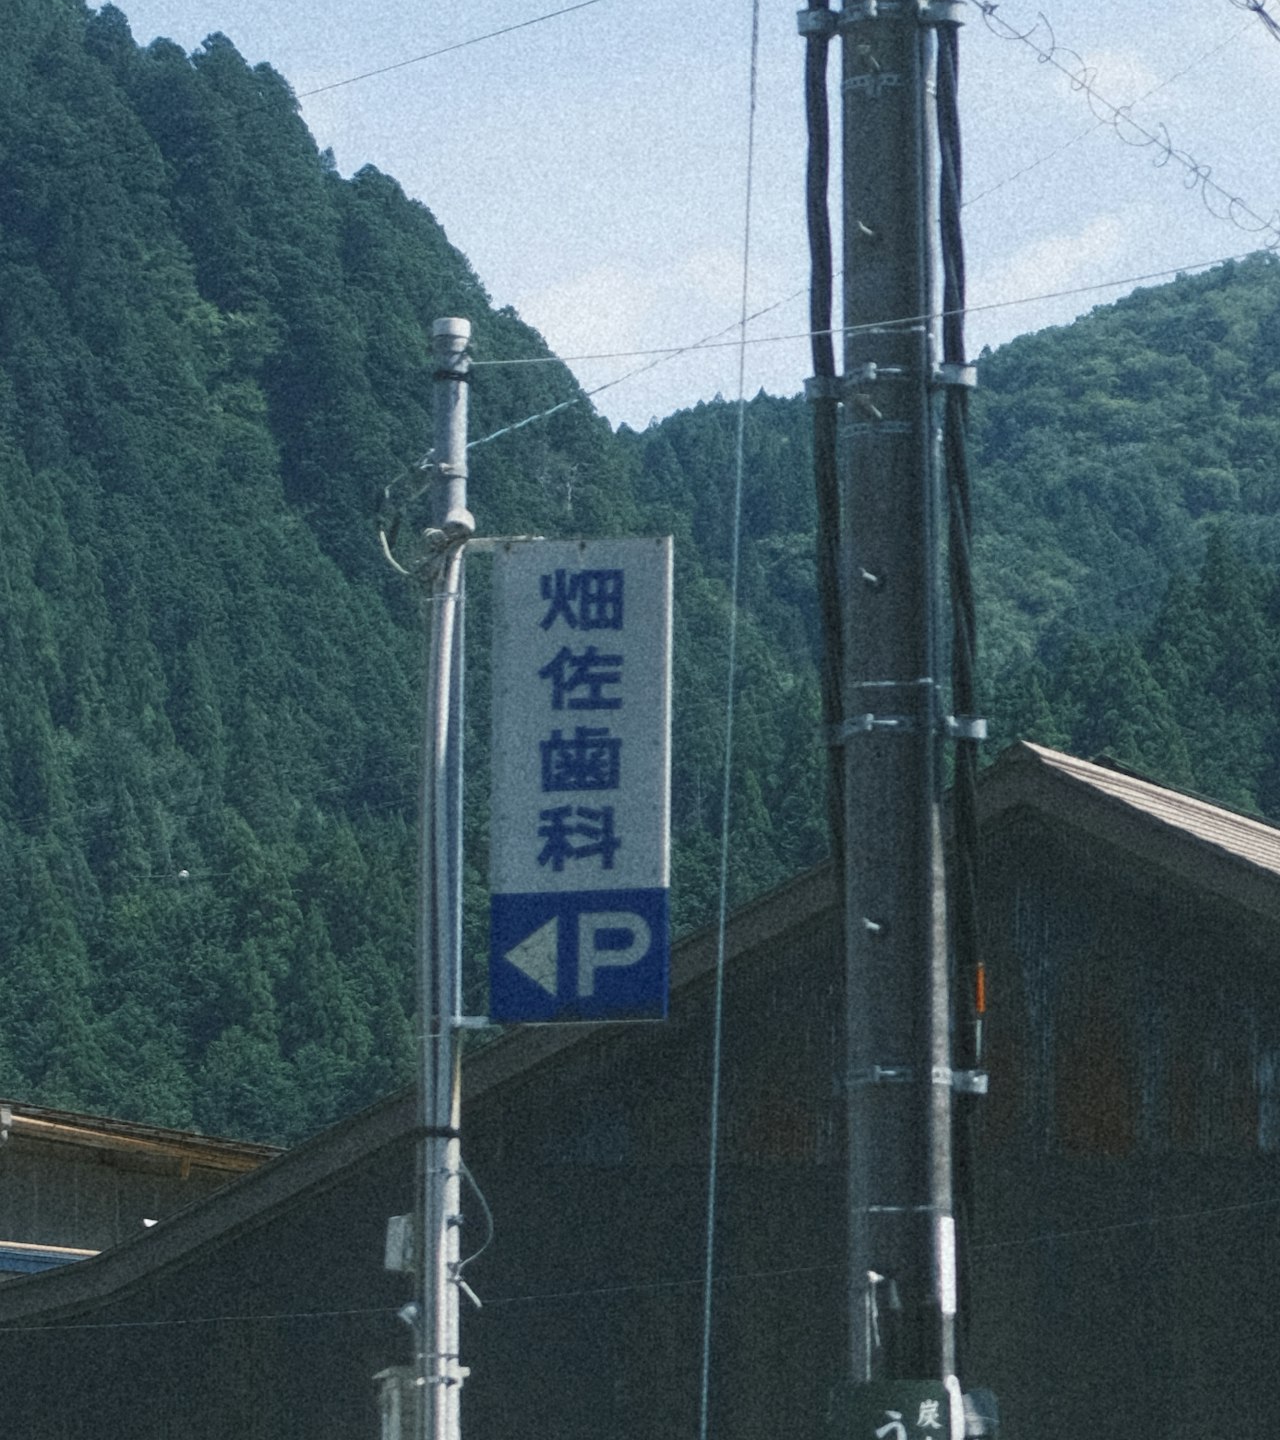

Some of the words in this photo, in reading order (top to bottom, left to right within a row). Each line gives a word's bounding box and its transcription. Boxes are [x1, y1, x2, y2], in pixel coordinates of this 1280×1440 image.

[537, 568, 625, 873] 畑佐歯科
[577, 910, 652, 997] P
